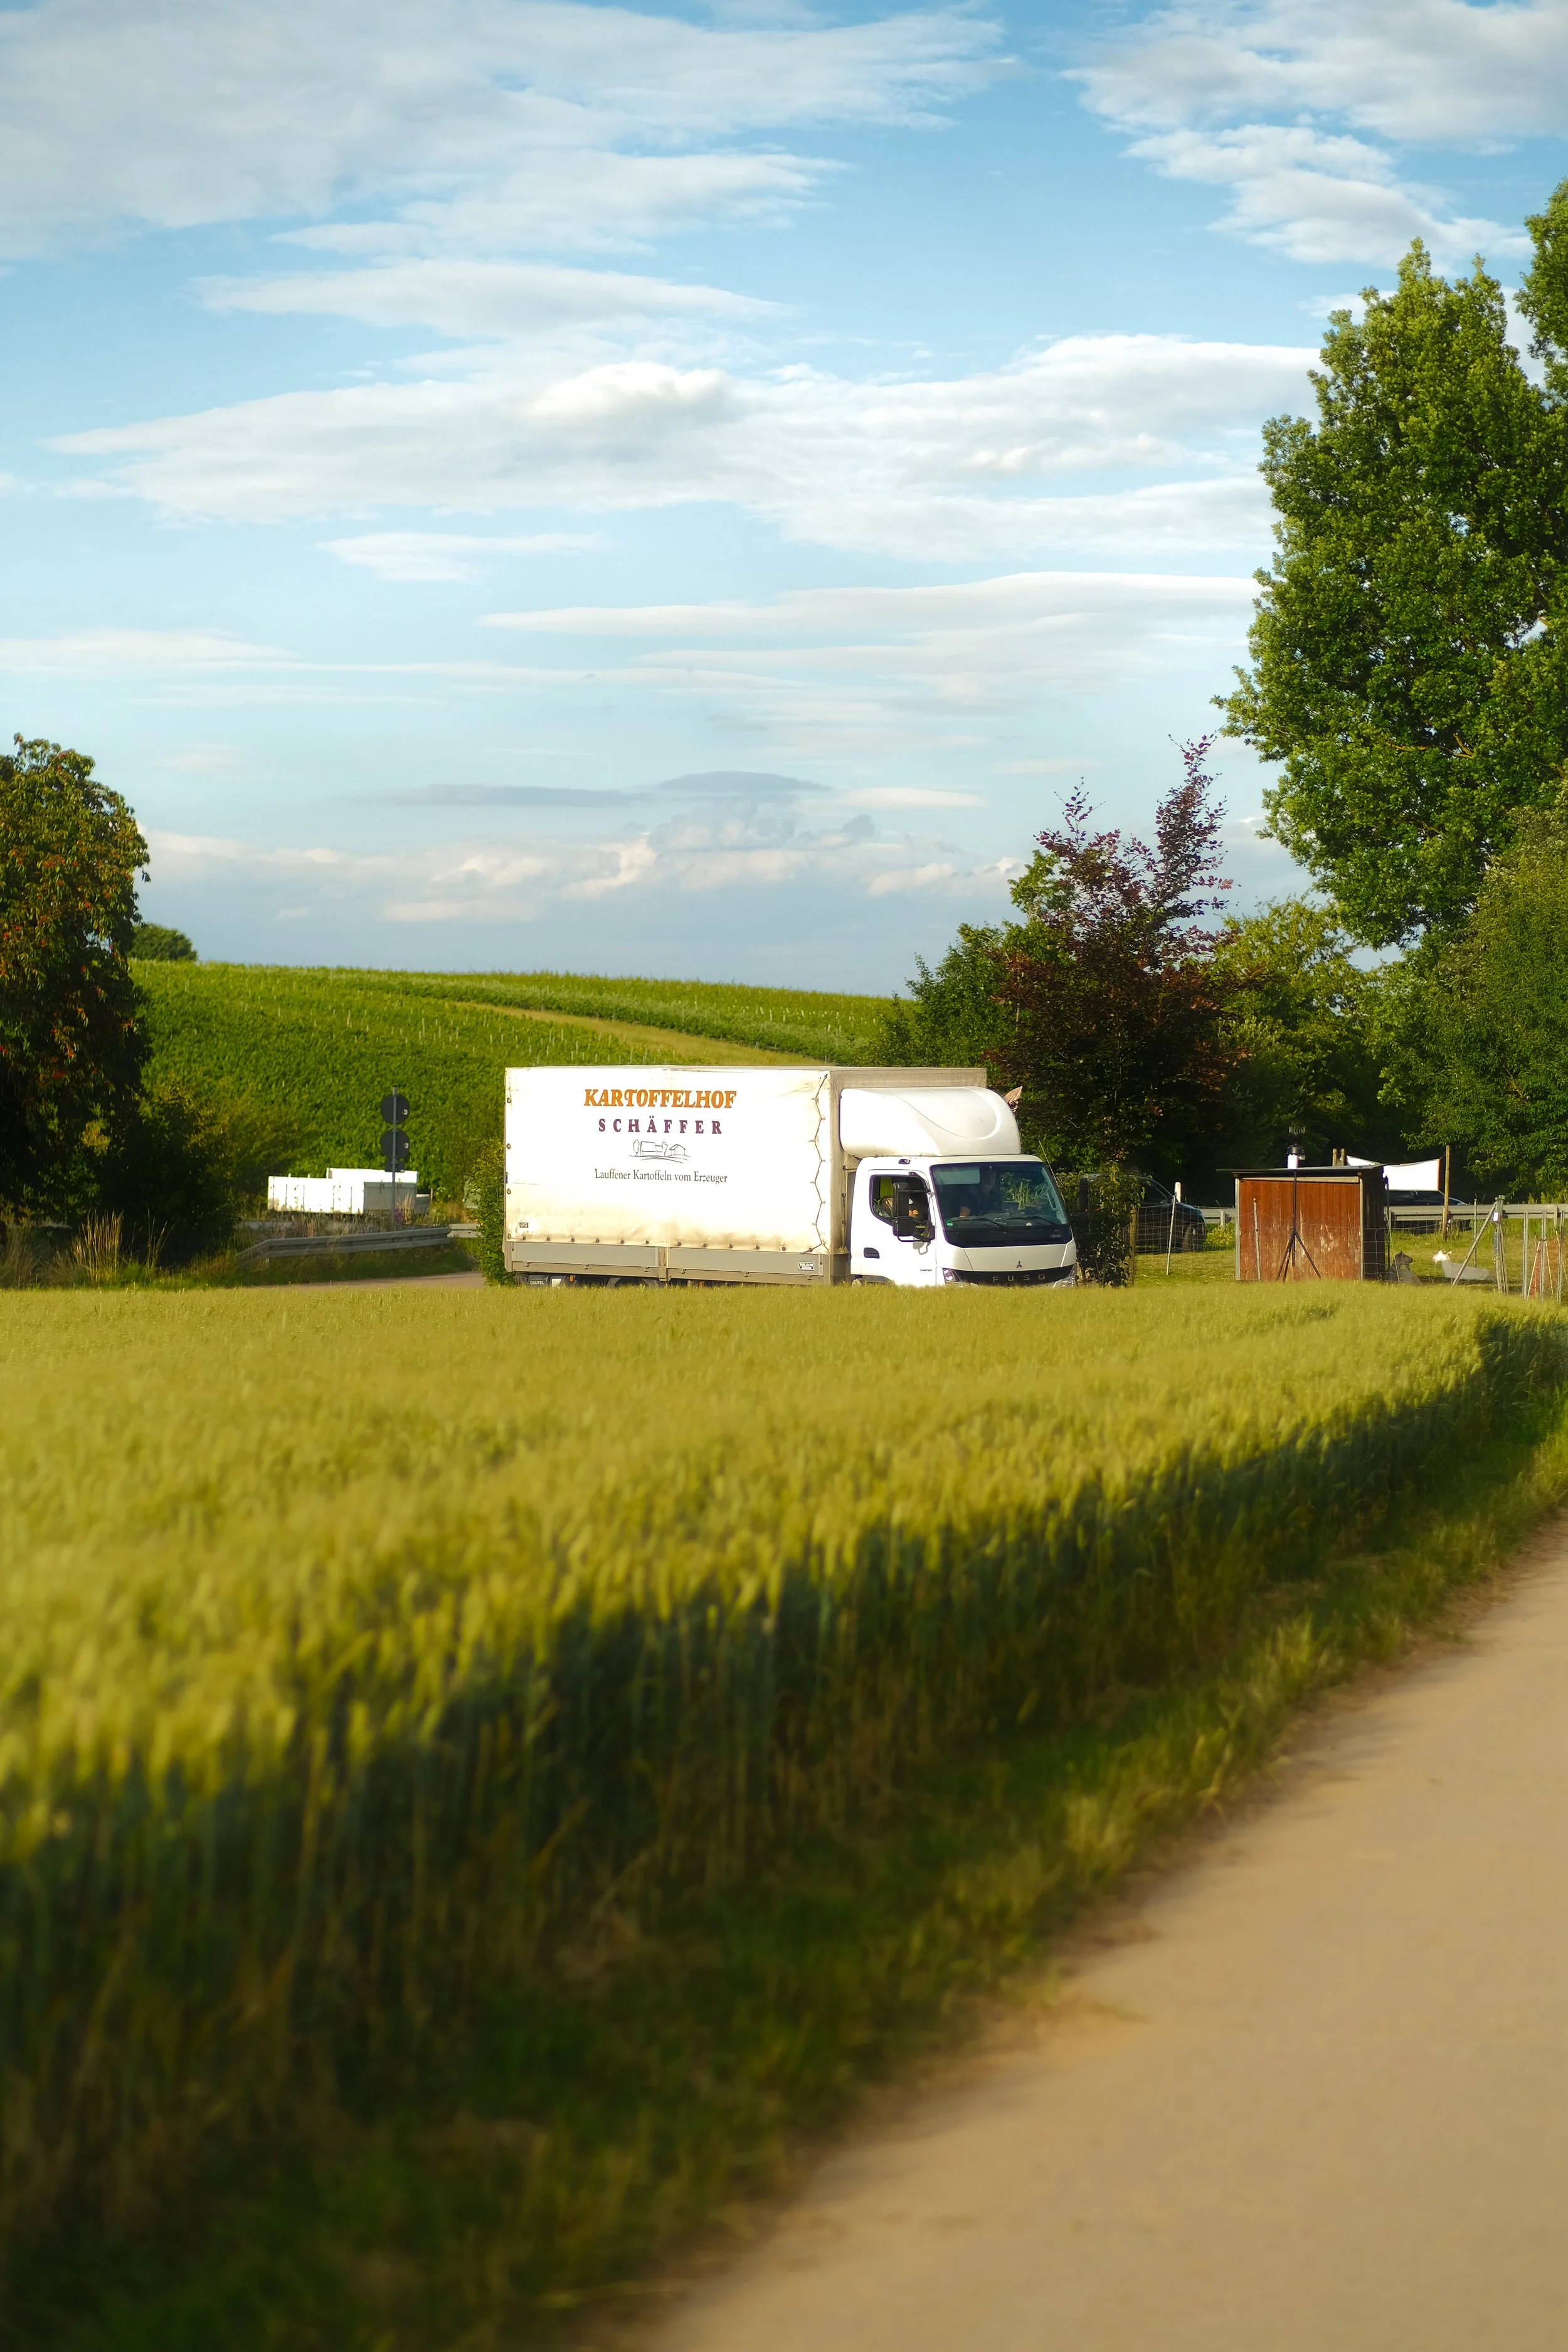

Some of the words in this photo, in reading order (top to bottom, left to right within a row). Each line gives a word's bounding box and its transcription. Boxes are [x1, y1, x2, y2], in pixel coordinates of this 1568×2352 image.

[584, 1089, 737, 1108] KARTOFFELHOF
[598, 1115, 722, 1134] SCHÄFFER
[594, 1168, 631, 1180] Lauffener
[633, 1169, 672, 1181] Kartoffeln
[674, 1173, 691, 1182] vom
[694, 1171, 728, 1185] Erzeuger
[992, 1274, 1046, 1283] FUSO
